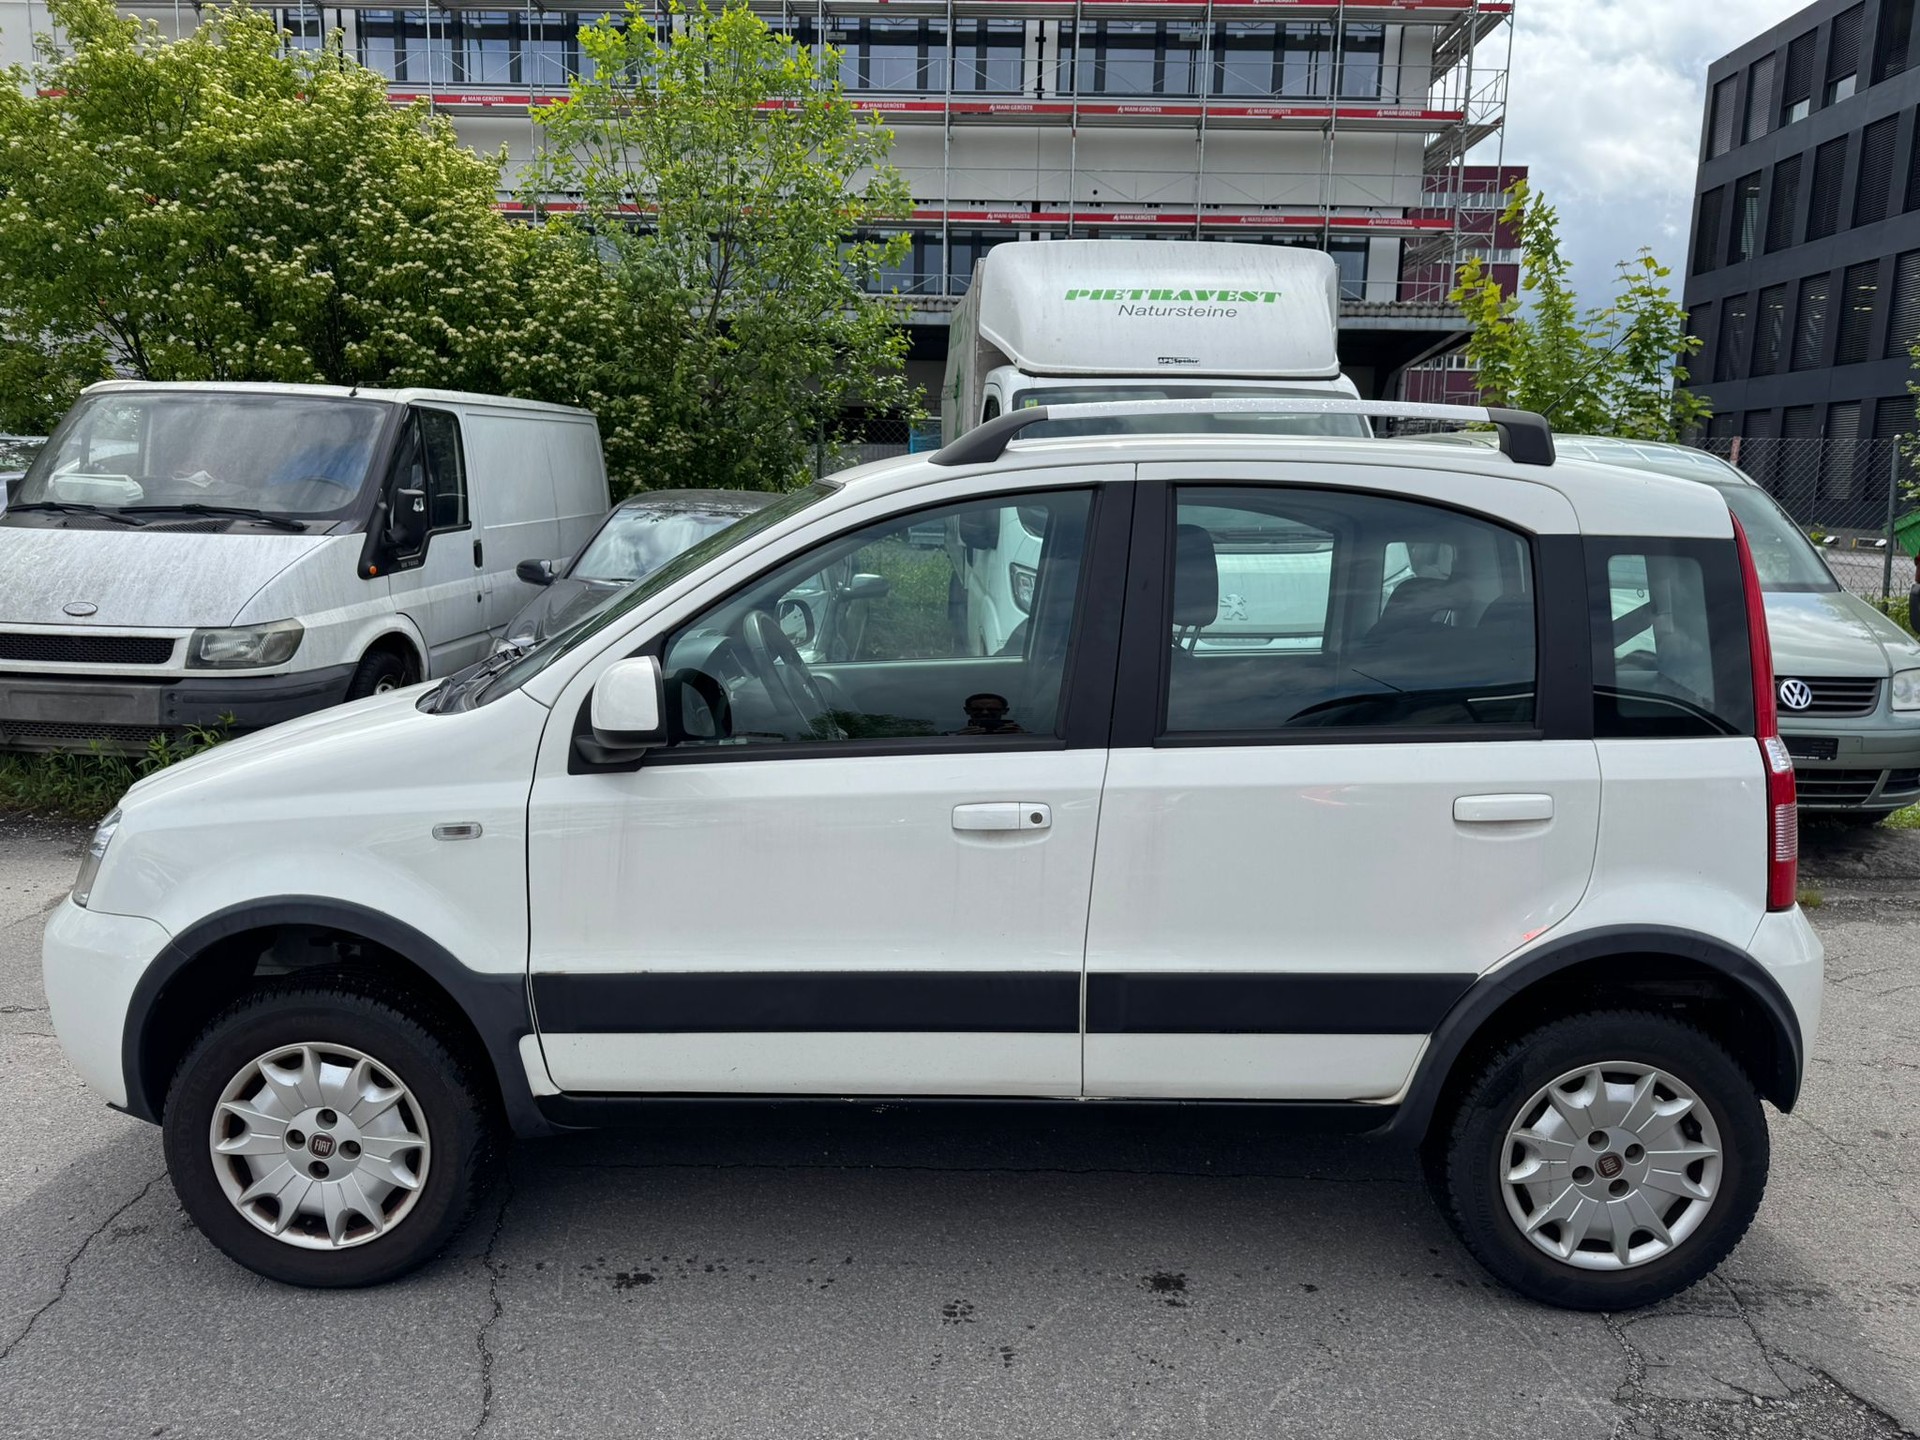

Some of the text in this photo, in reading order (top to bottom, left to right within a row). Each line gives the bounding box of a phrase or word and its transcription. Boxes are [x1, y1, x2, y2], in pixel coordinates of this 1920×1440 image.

[1064, 289, 1282, 303] PIETRAVEST
[1117, 304, 1238, 318] Natursteine
[1780, 680, 1812, 709] VW
[314, 1139, 331, 1153] FIAT
[1601, 1157, 1618, 1174] FIAT
